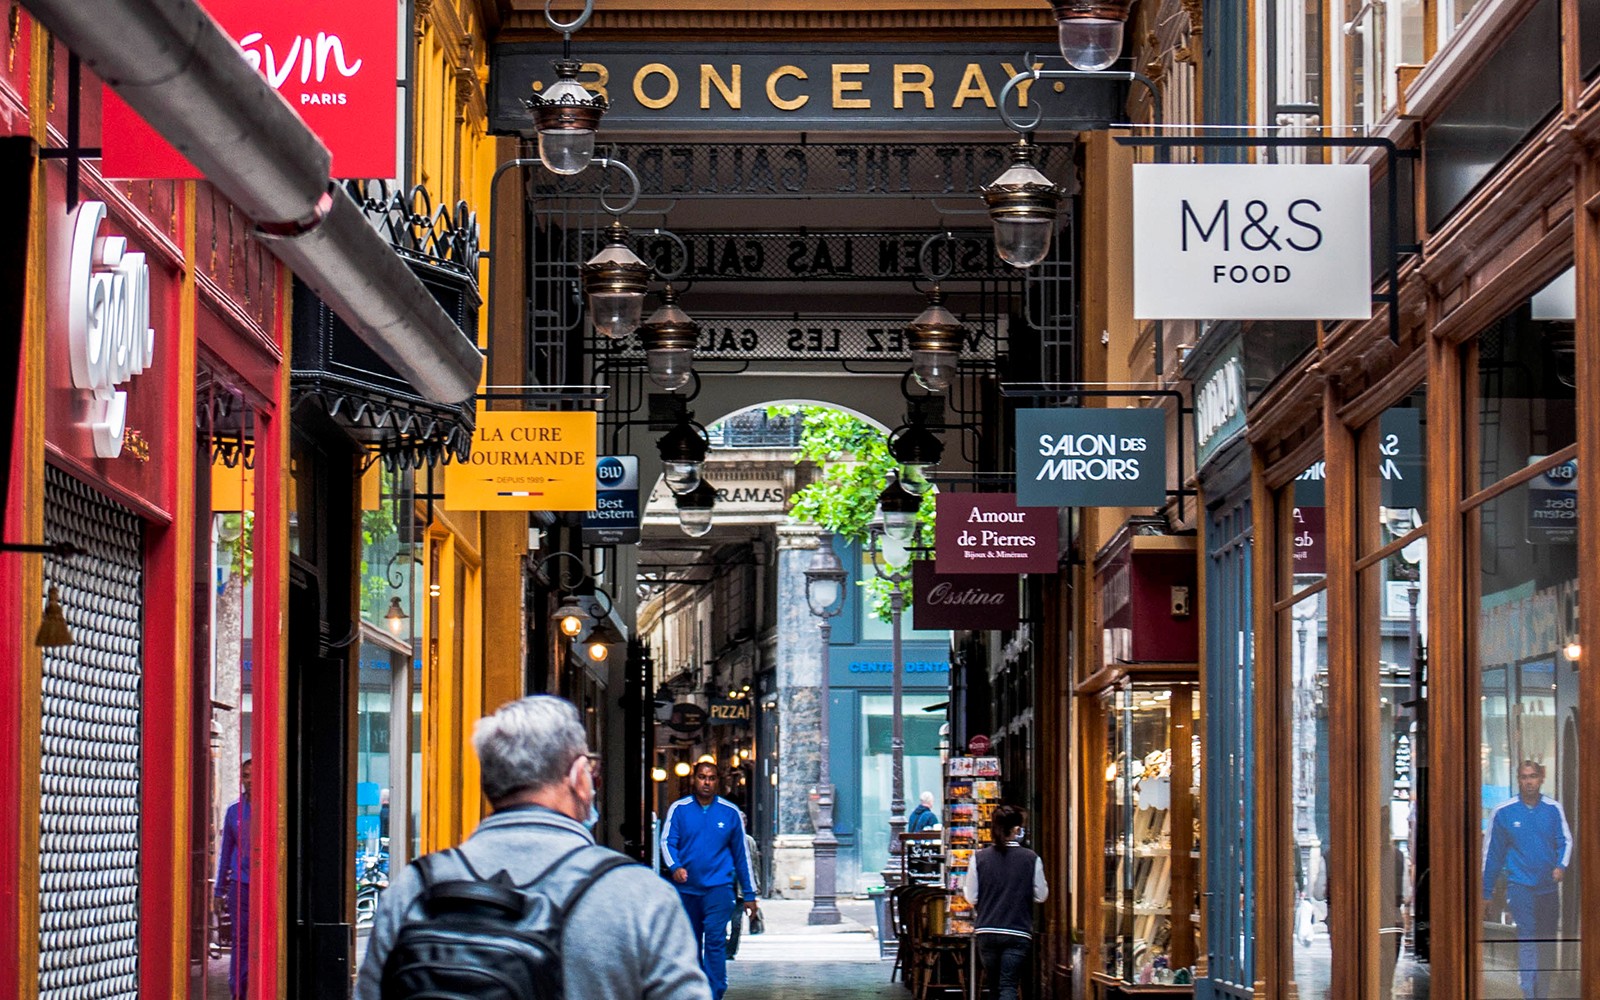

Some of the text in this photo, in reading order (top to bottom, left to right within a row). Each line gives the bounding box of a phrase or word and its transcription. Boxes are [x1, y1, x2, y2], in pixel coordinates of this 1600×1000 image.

[300, 93, 347, 105] PARIS
[1181, 198, 1323, 252] M&S
[1213, 265, 1292, 284] FOOD
[480, 427, 562, 442] LA CURE
[1038, 433, 1148, 457] SALON DES
[599, 466, 623, 479] BW
[1035, 458, 1141, 481] MIROIRS
[715, 487, 784, 503] RAMAS
[597, 498, 624, 509] Best
[586, 510, 635, 520] Western
[967, 506, 1026, 523] Amour
[957, 530, 1037, 547] de Pierres
[964, 550, 987, 560] Bijoux
[986, 550, 996, 559] &
[848, 661, 950, 674] CENTR DENTA
